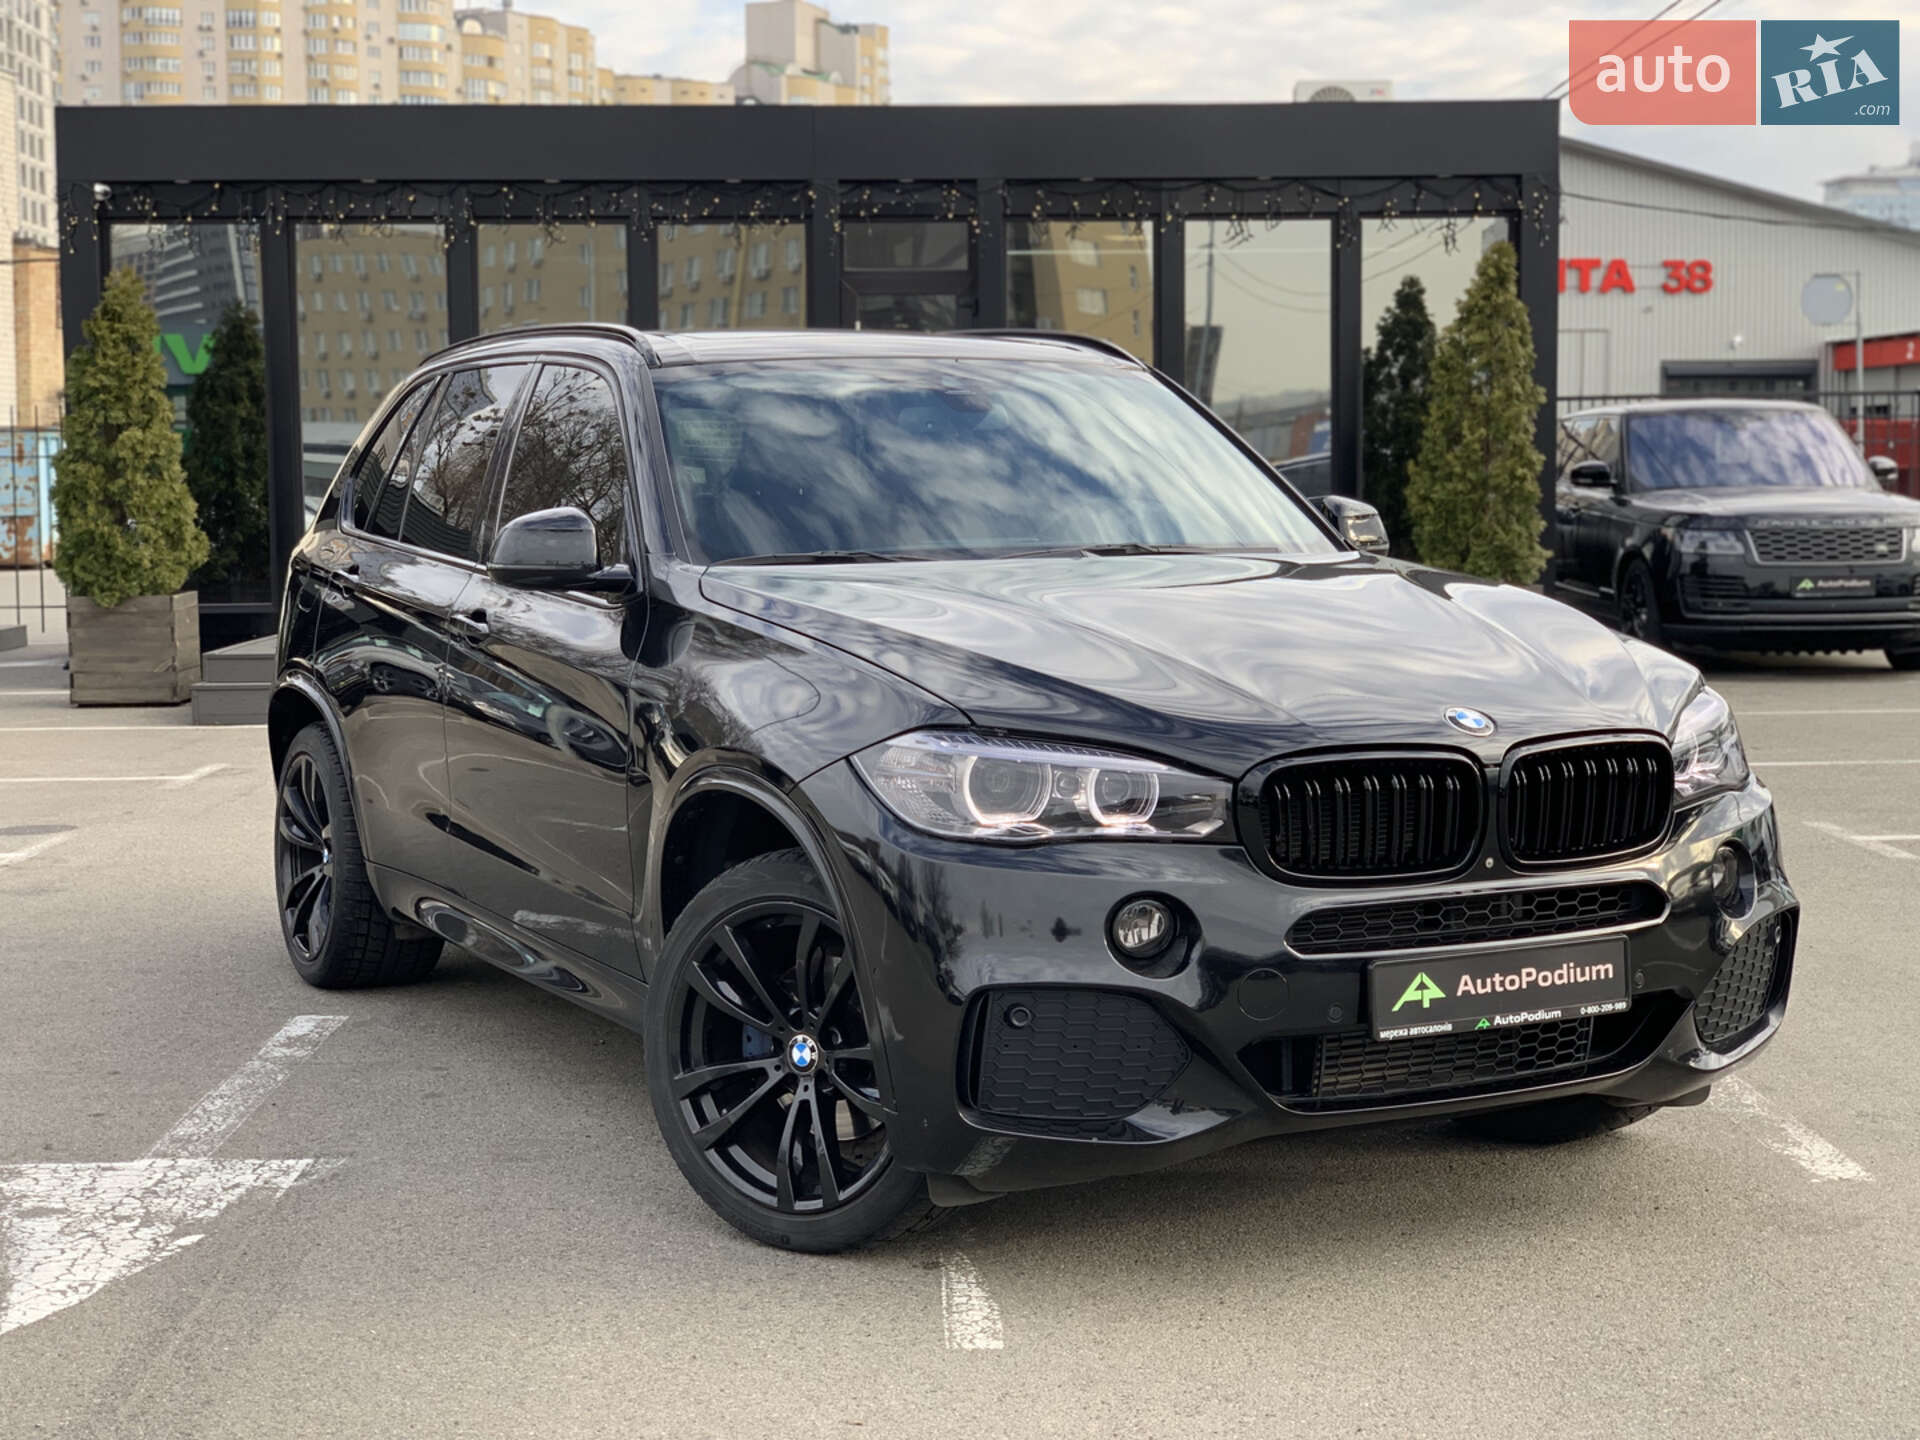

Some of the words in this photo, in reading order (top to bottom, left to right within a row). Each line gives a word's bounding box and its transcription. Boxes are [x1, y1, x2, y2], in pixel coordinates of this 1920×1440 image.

[1662, 259, 1713, 294] 38
[1456, 962, 1614, 997] AutoPodium
[1494, 1009, 1562, 1026] AutoPodium
